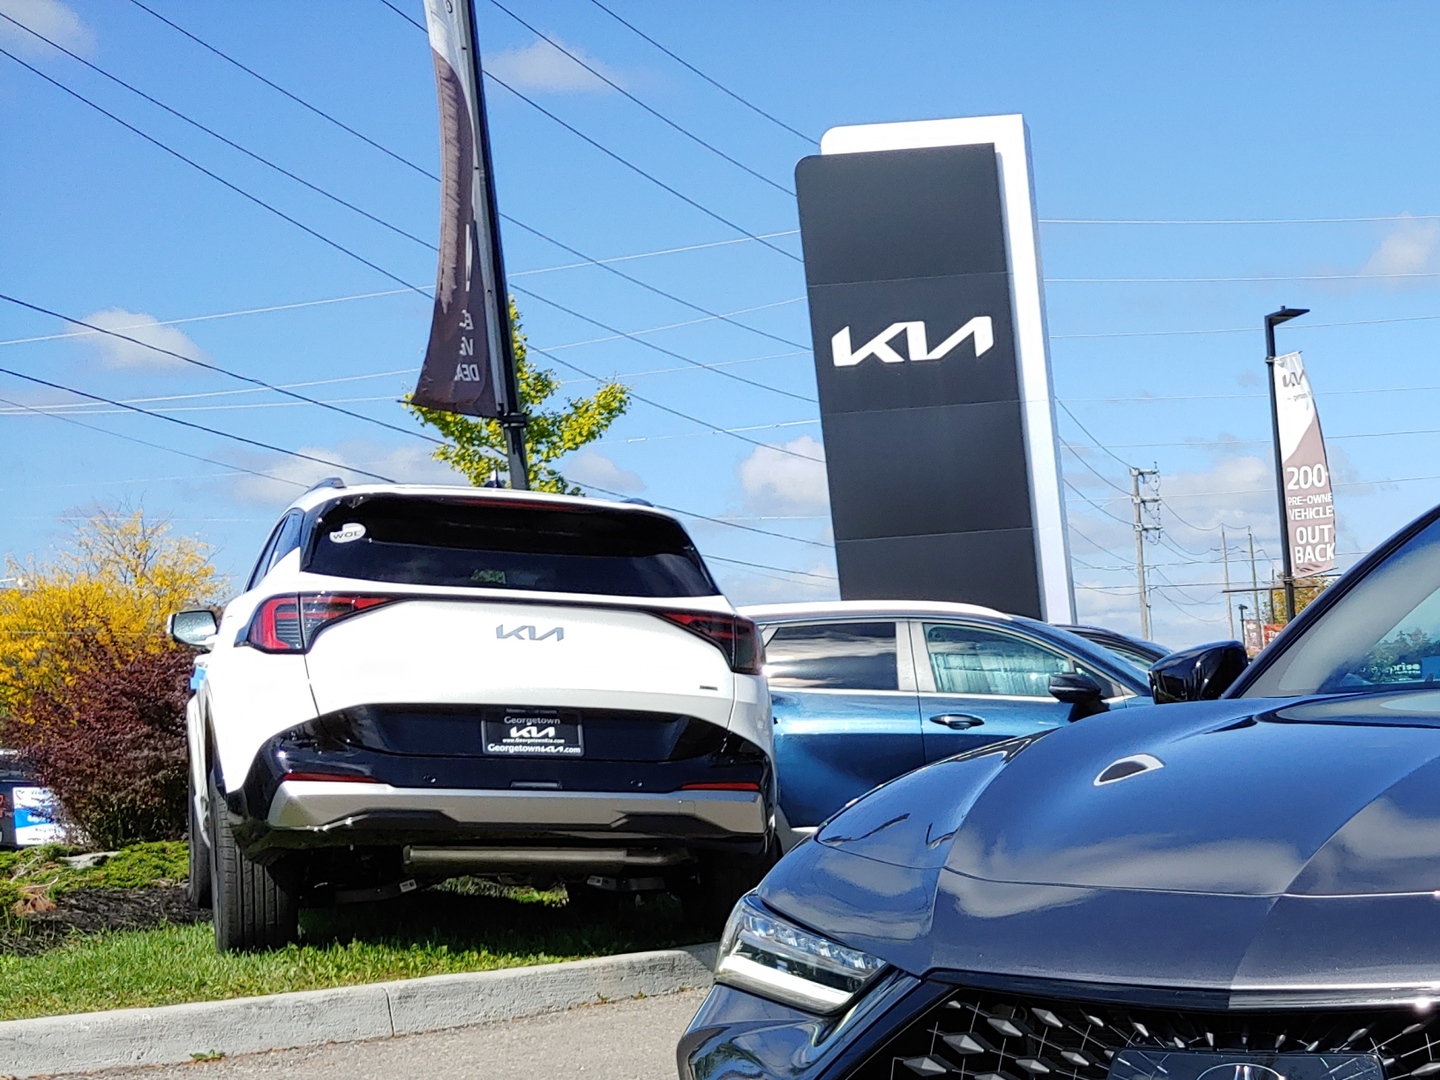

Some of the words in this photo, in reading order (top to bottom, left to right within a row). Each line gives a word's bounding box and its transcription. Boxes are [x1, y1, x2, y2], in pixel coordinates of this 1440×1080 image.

[831, 316, 994, 367] KIA
[1286, 463, 1328, 490] 200
[1287, 492, 1332, 506] PRE-OWNE
[1289, 505, 1334, 521] VEHICLE
[1296, 524, 1332, 544] OUT
[1294, 542, 1335, 564] BACK
[496, 624, 564, 642] KIA
[504, 716, 561, 725] Georgetown
[510, 726, 555, 738] KIA
